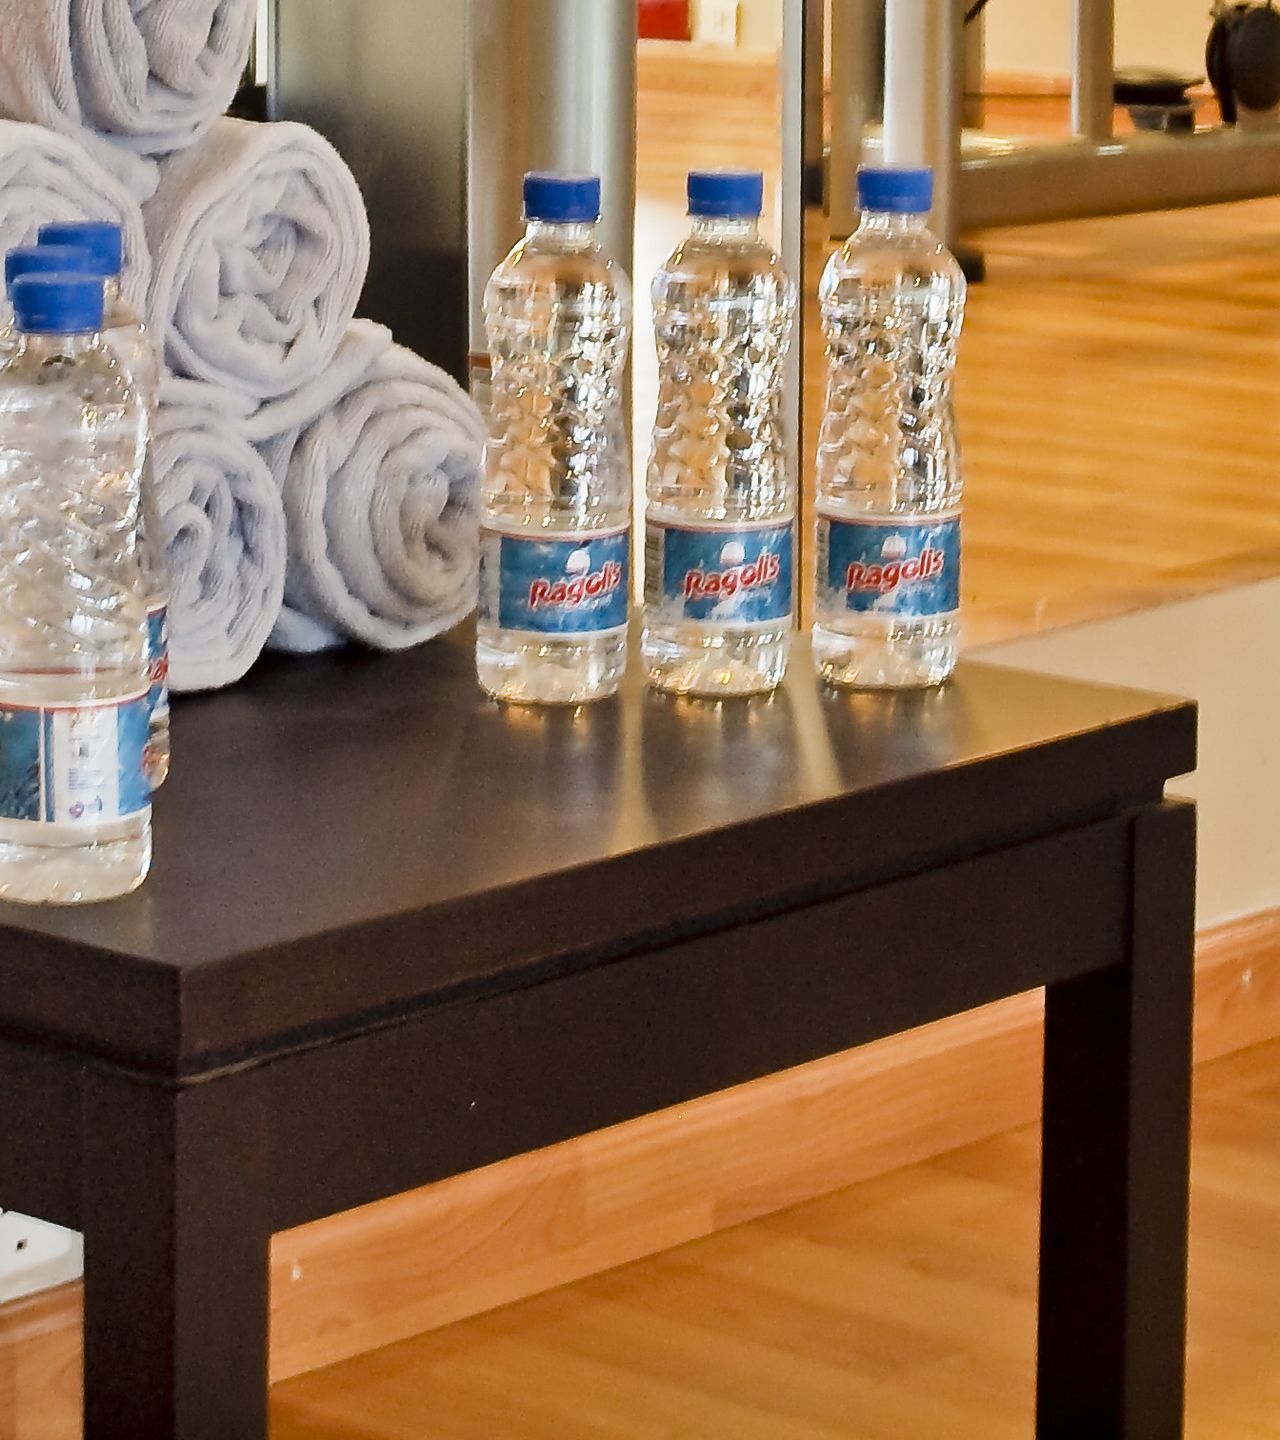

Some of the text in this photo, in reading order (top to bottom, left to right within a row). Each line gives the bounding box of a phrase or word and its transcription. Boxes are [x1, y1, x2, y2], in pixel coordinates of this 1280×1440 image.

[529, 561, 622, 610] Ragolis
[683, 553, 780, 600] Ragolis
[846, 548, 945, 594] Ragolis
